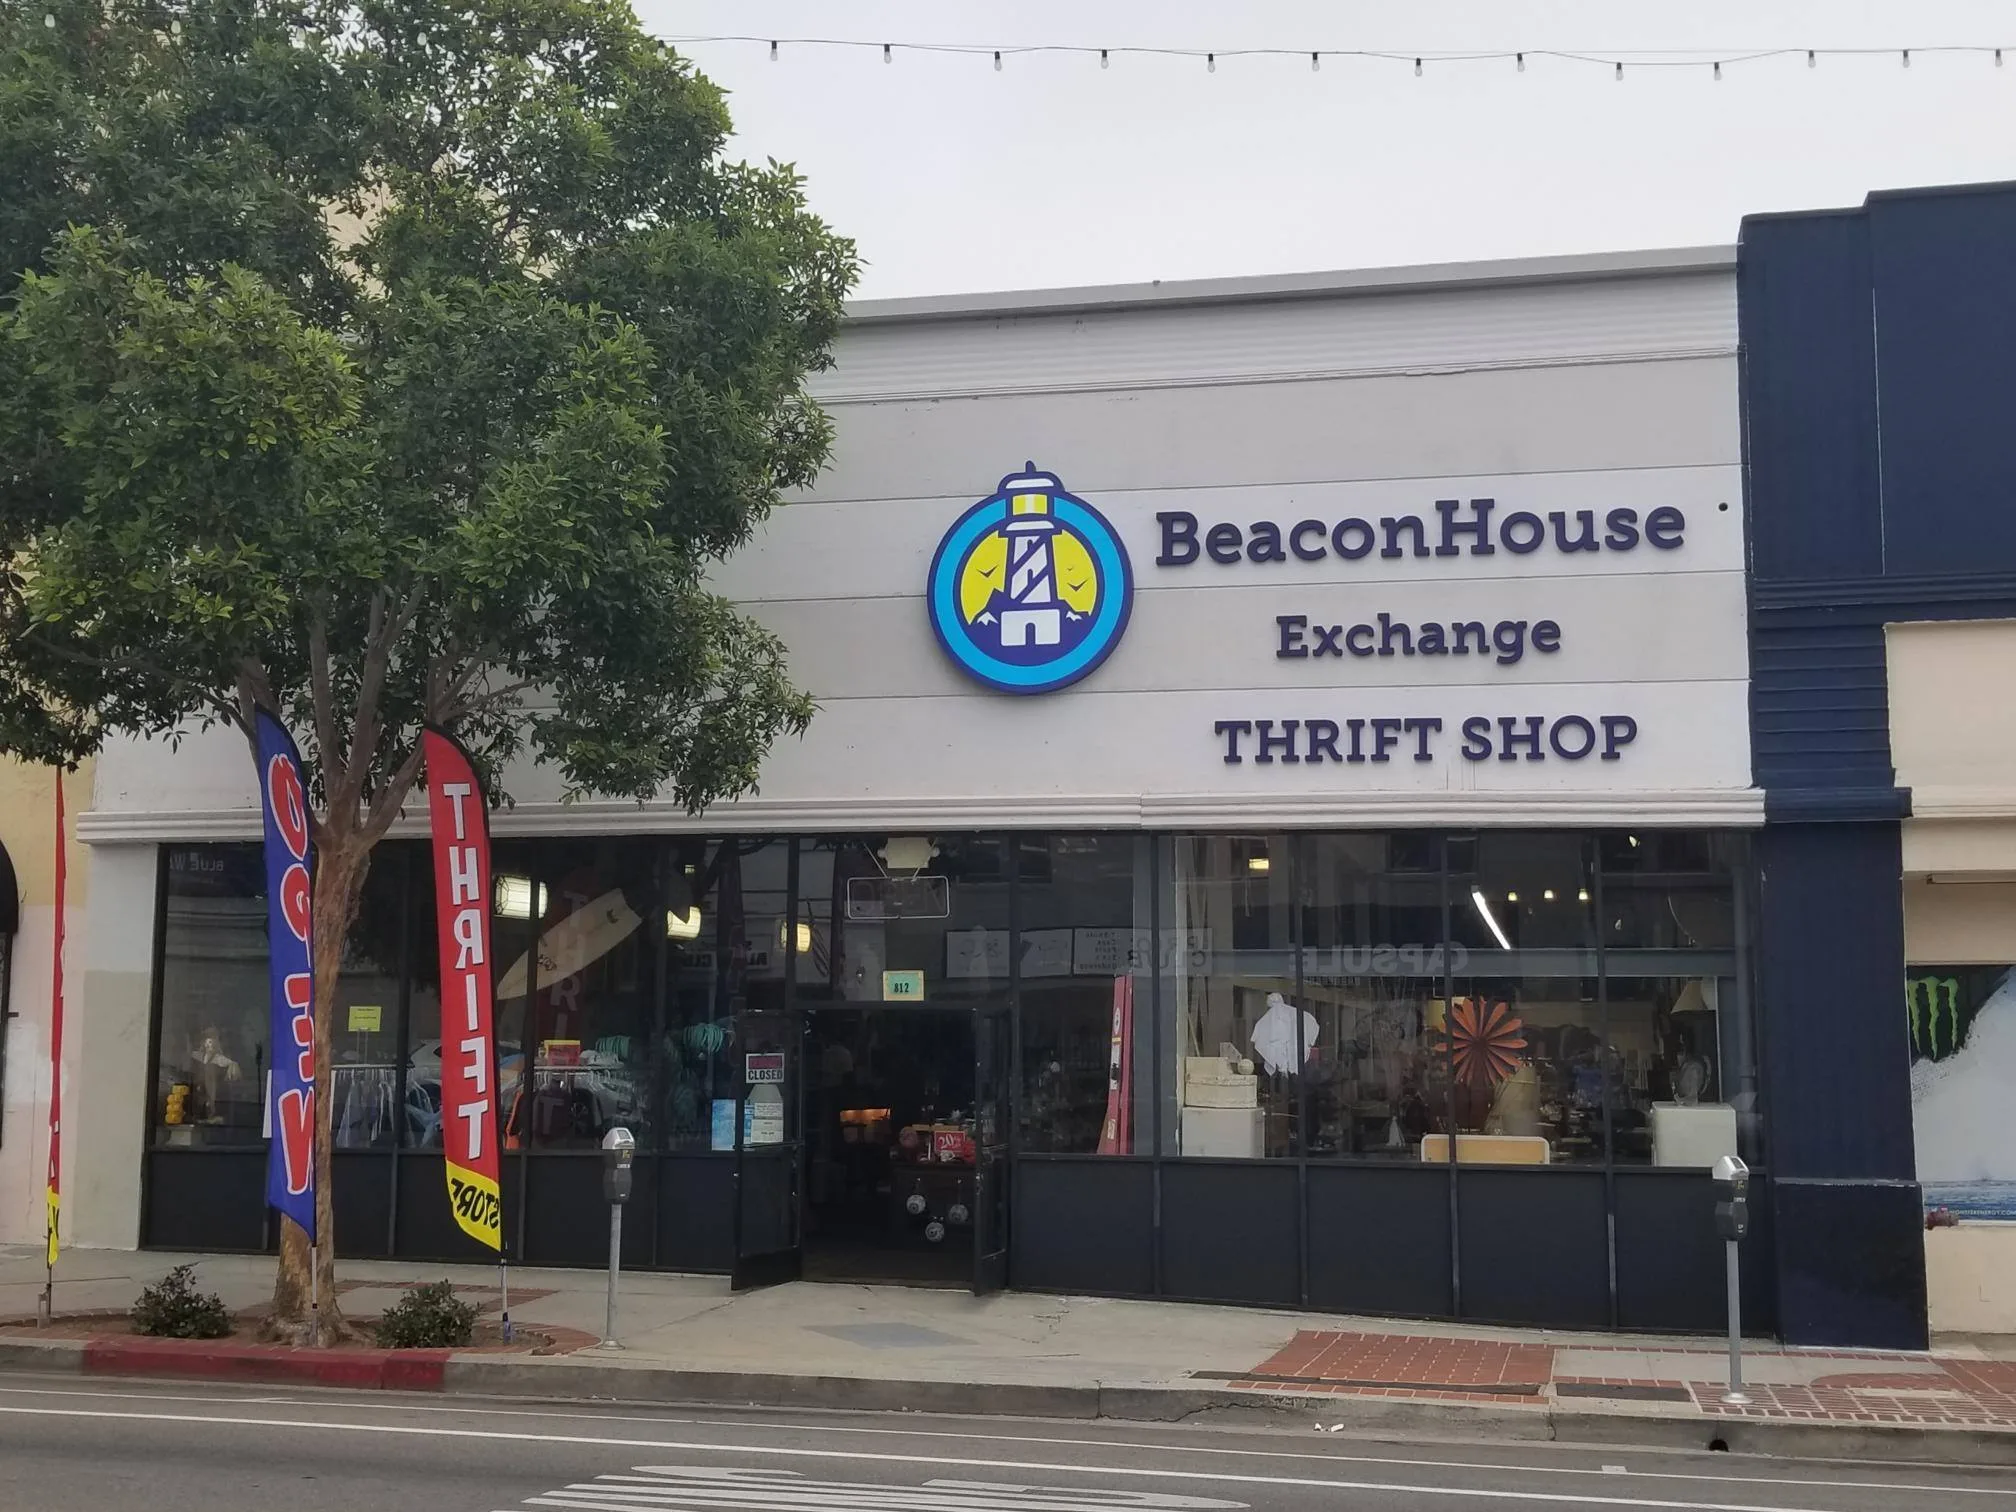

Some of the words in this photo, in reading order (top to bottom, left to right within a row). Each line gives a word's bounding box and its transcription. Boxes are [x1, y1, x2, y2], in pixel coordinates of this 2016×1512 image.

[1155, 498, 1686, 567] BeaconHouse
[1276, 612, 1562, 665] Exchange
[1214, 717, 1443, 764] THRIFT
[1460, 714, 1639, 762] SHOP
[893, 982, 911, 993] 812
[748, 1069, 783, 1080] CLOSED
